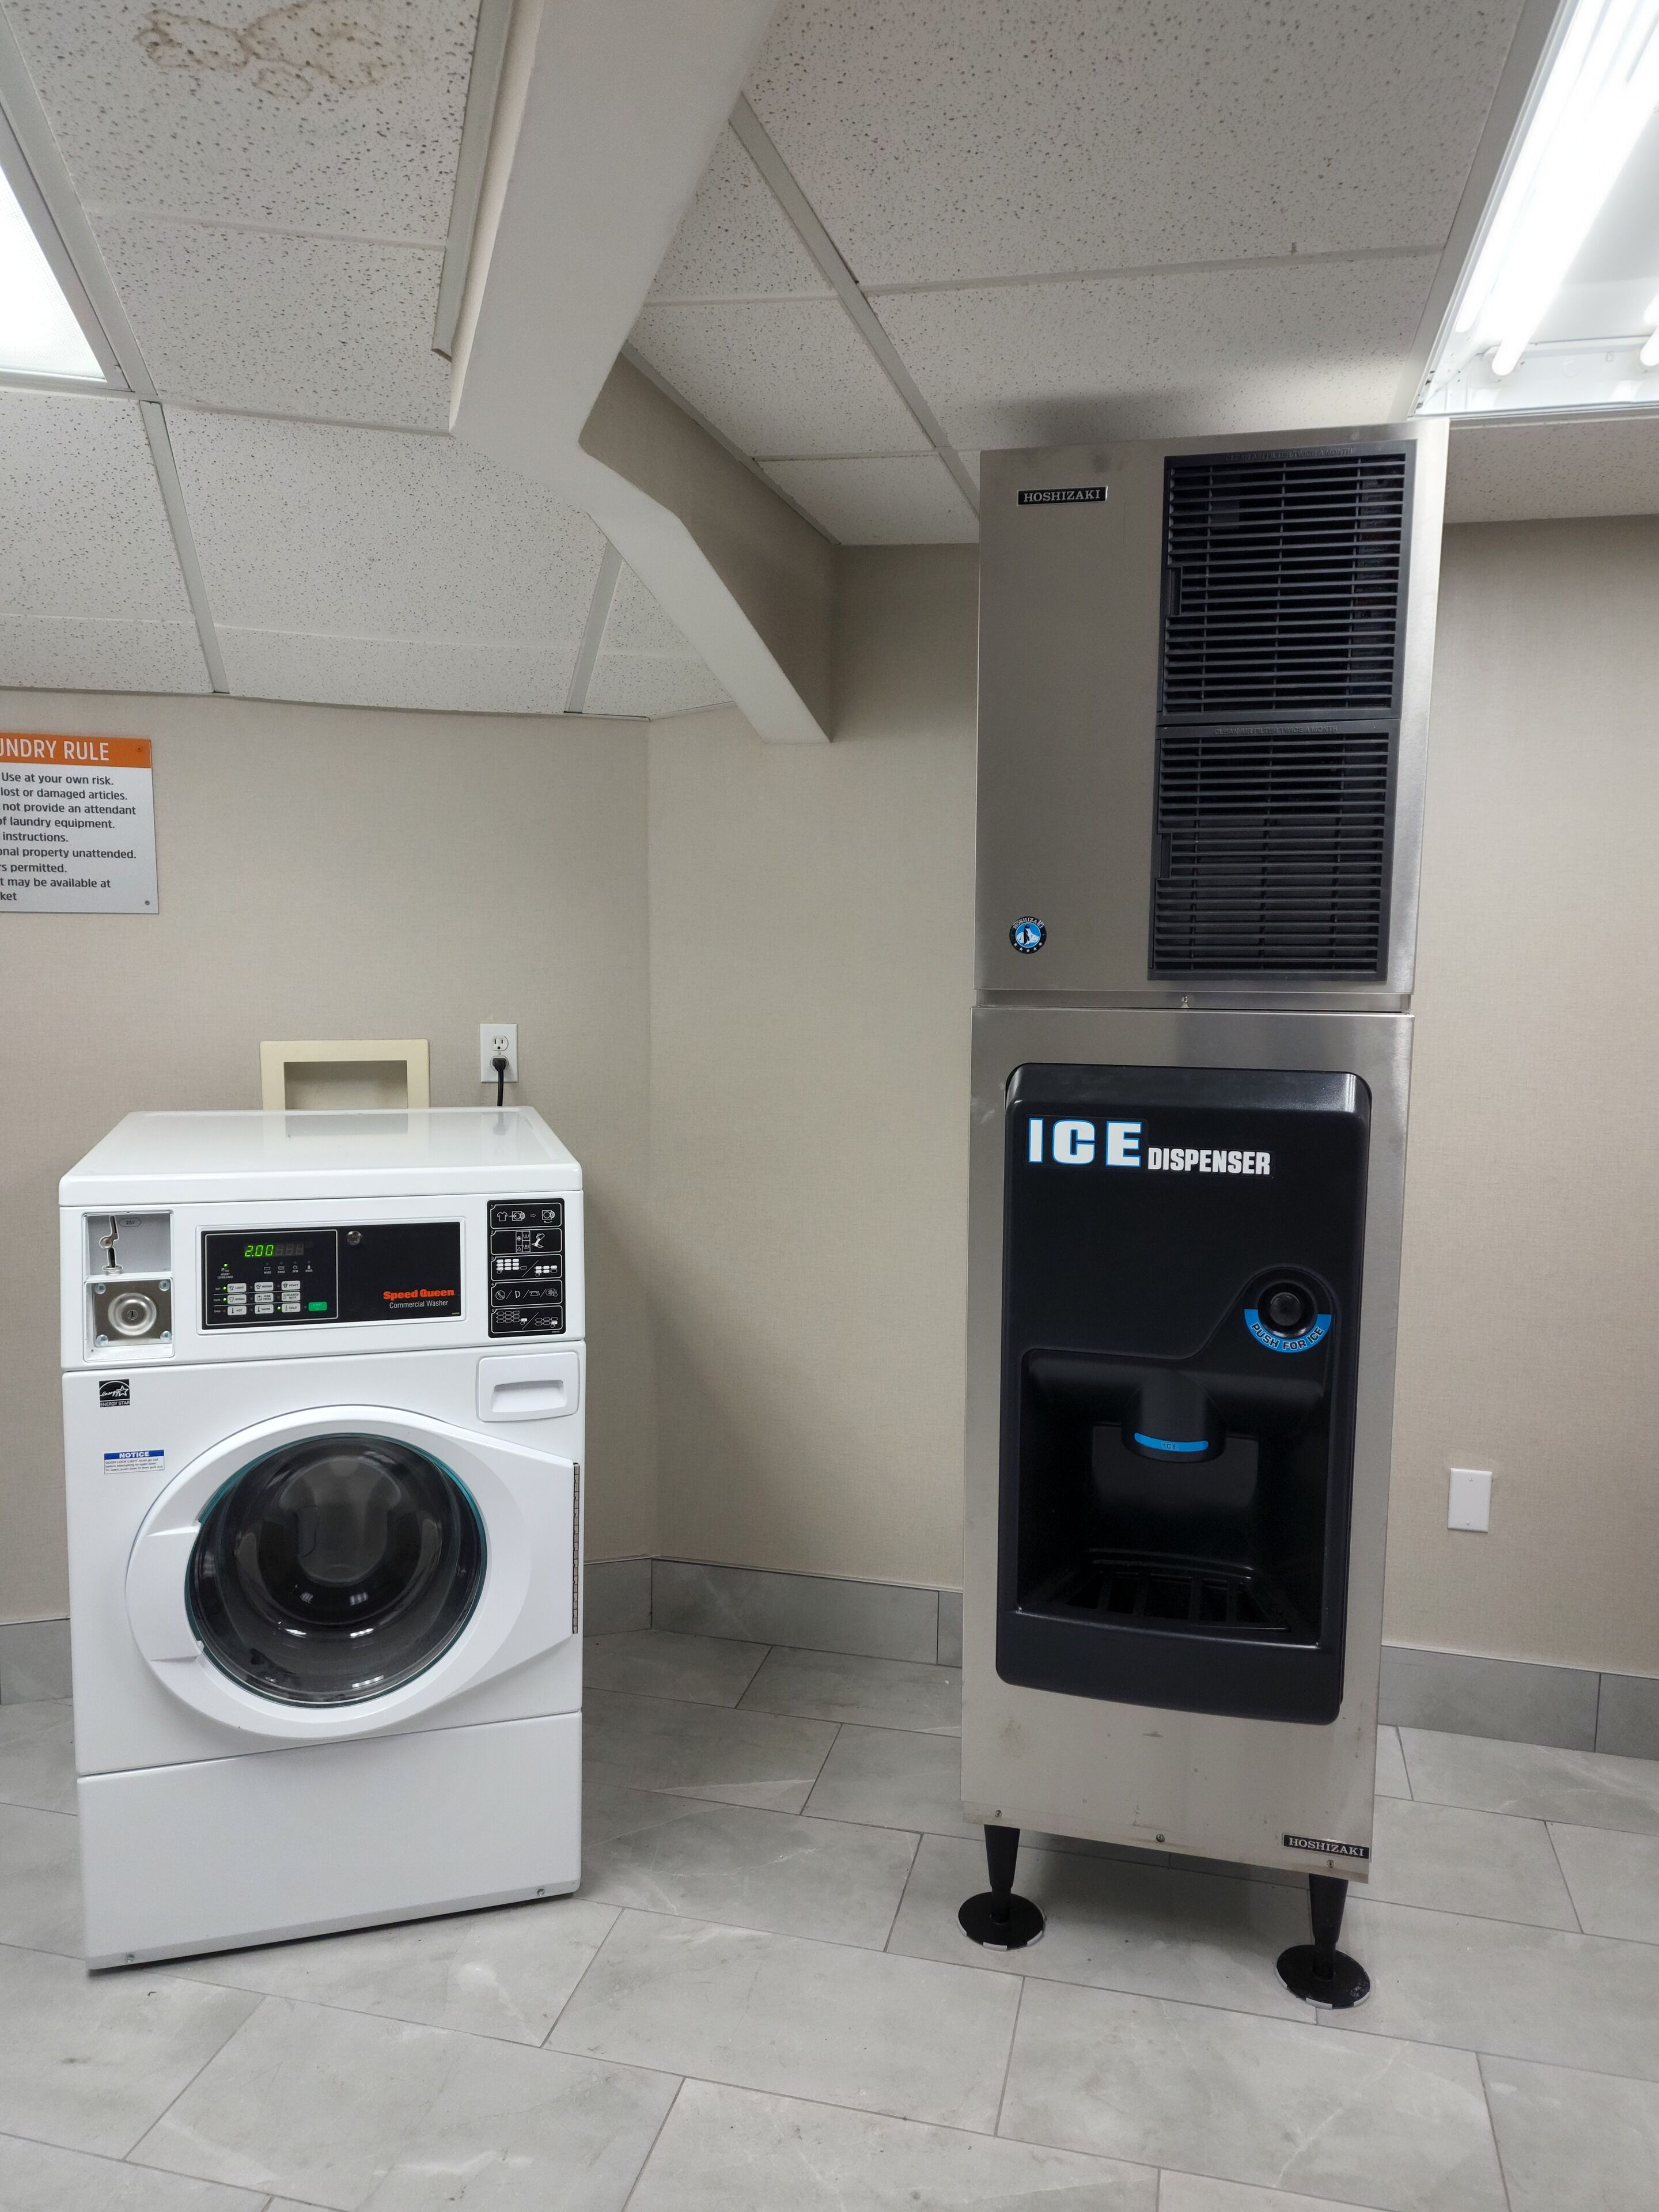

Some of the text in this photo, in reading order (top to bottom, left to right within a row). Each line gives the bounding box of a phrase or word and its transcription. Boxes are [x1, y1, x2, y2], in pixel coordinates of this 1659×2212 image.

[1325, 448, 1353, 456] MONTH
[1024, 490, 1101, 502] HOSHIZAKI
[63, 740, 109, 760] RULE
[1, 772, 113, 785] Use at your own risk.
[0, 787, 20, 796] lost
[37, 788, 85, 800] damaged
[88, 790, 127, 800] articles.
[2, 802, 21, 811] not
[24, 803, 65, 812] provide
[84, 805, 136, 815] attendant
[10, 816, 51, 828] laundry
[54, 819, 115, 829] equipment.
[2, 831, 69, 842] instructions.
[0, 847, 137, 859] nal property unattended.
[10, 863, 67, 873] permitted.
[7, 878, 30, 887] may
[33, 878, 47, 887] be
[50, 878, 97, 887] available
[100, 879, 111, 888] at
[1013, 917, 1044, 929] HOSHIZAKI
[1028, 1118, 1271, 1175] ICE DISPENSER
[245, 1244, 274, 1256] 2.00
[383, 1289, 454, 1301] Speed Queen
[389, 1301, 425, 1309] Commercial
[1251, 1322, 1325, 1350] PUSH FOR ICE
[1289, 1838, 1364, 1856] HOSHIZAKI
